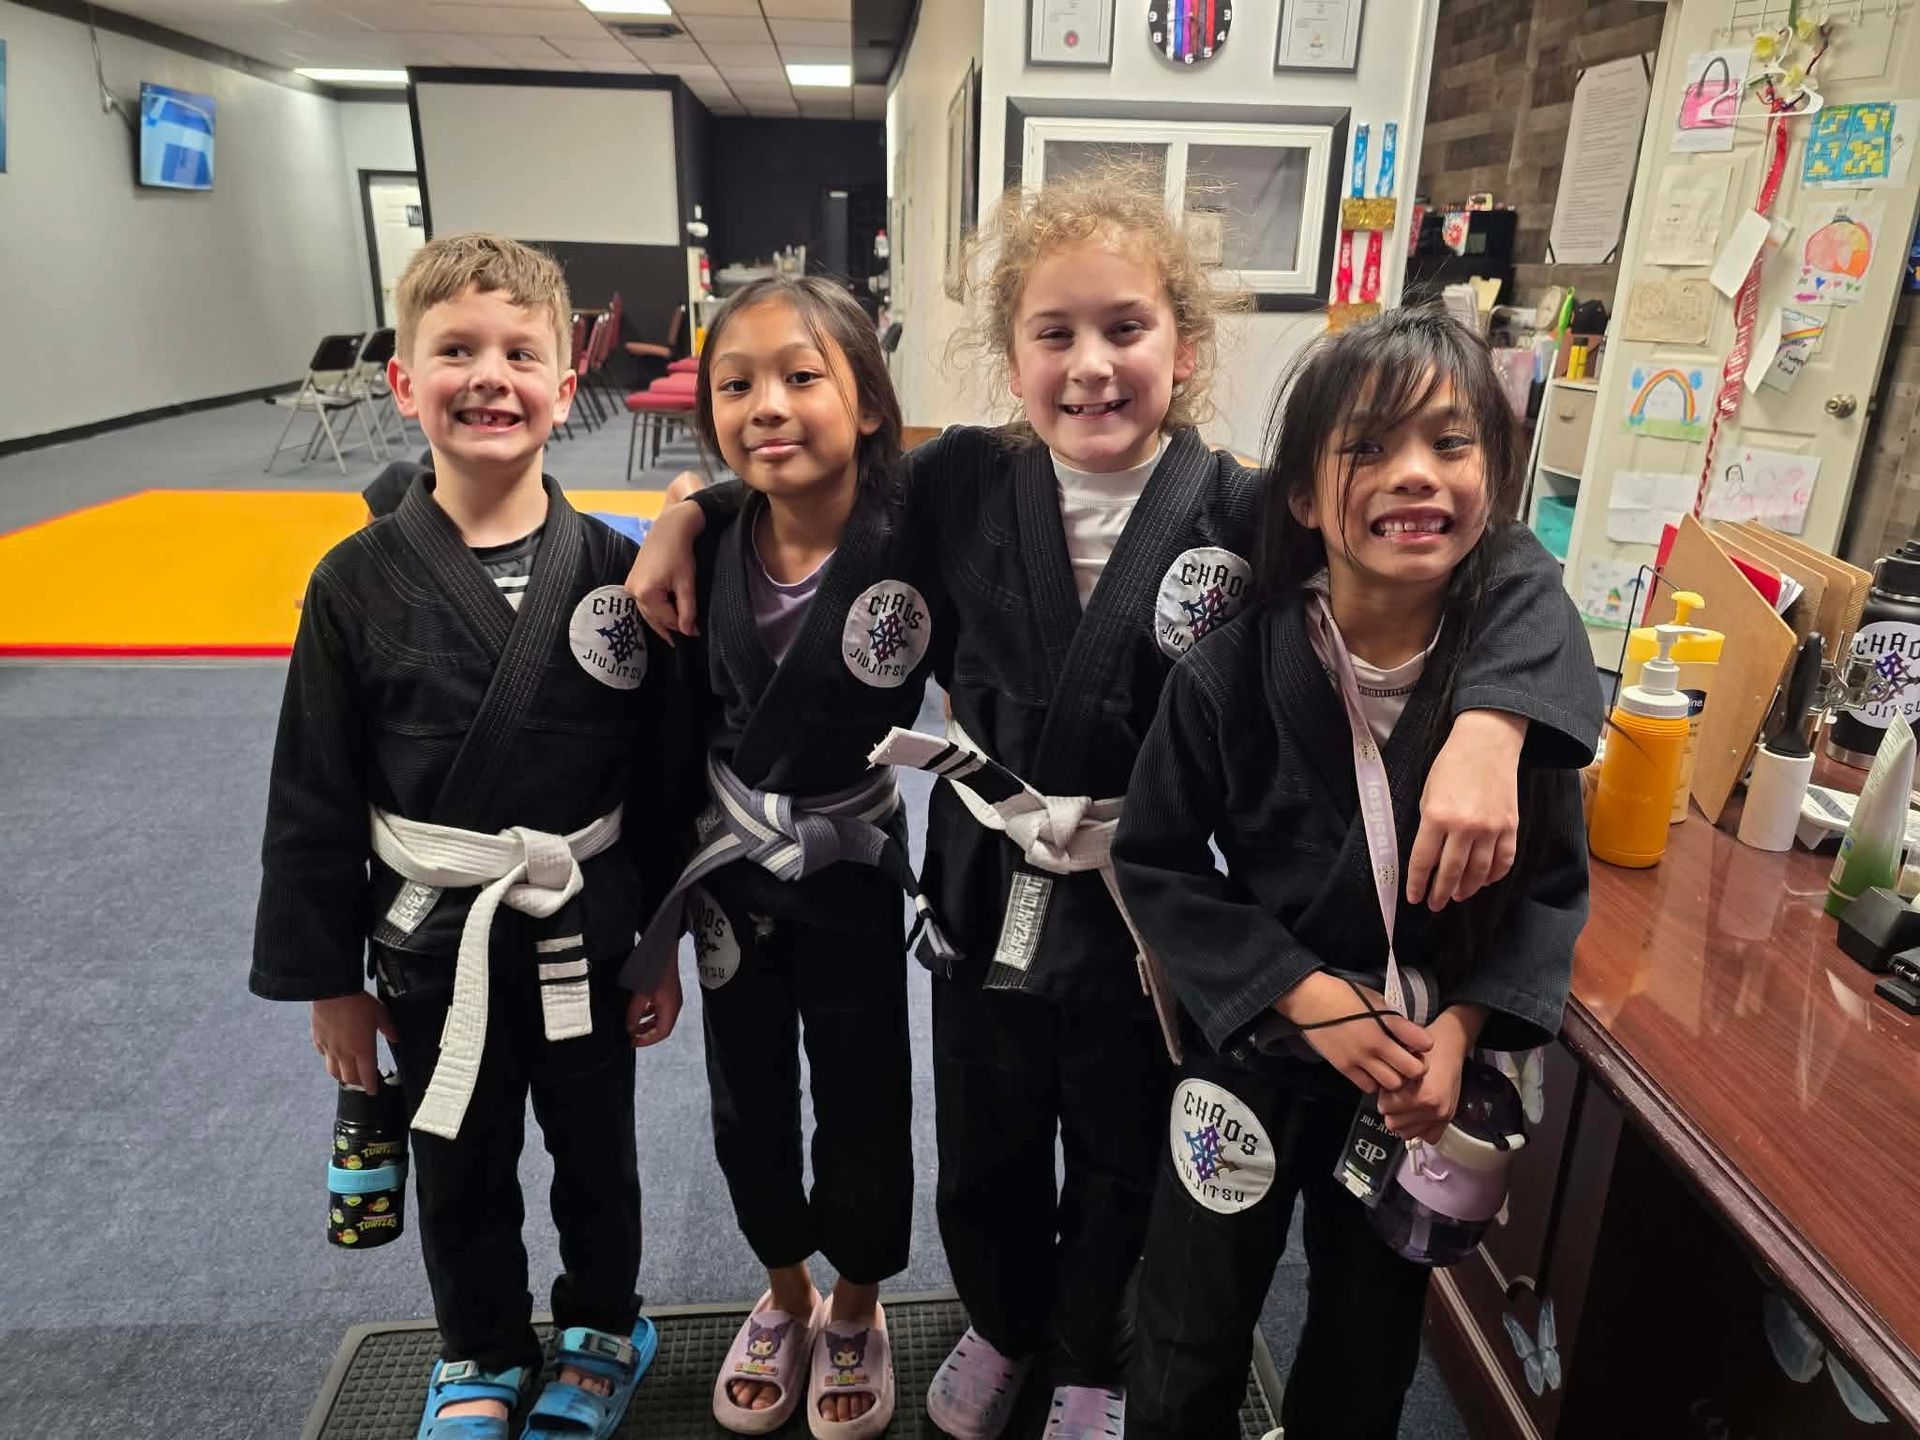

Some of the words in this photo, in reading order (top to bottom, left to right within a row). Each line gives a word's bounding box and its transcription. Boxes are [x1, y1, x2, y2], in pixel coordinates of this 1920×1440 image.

[1149, 11, 1158, 22] 9
[1224, 9, 1232, 21] 3
[1153, 32, 1162, 43] 8
[1217, 31, 1226, 42] 4
[1184, 53, 1194, 65] 6
[1203, 47, 1212, 58] 5
[1180, 563, 1248, 598] CHAO
[592, 596, 639, 617] CHA
[868, 591, 924, 629] CHAOS
[1161, 623, 1184, 646] JIU
[1855, 632, 1920, 660] CHAO
[583, 648, 607, 668] JIU
[849, 647, 870, 669] JIU
[1183, 1090, 1260, 1156] CHAOS
[1193, 1177, 1246, 1203] JITSU
